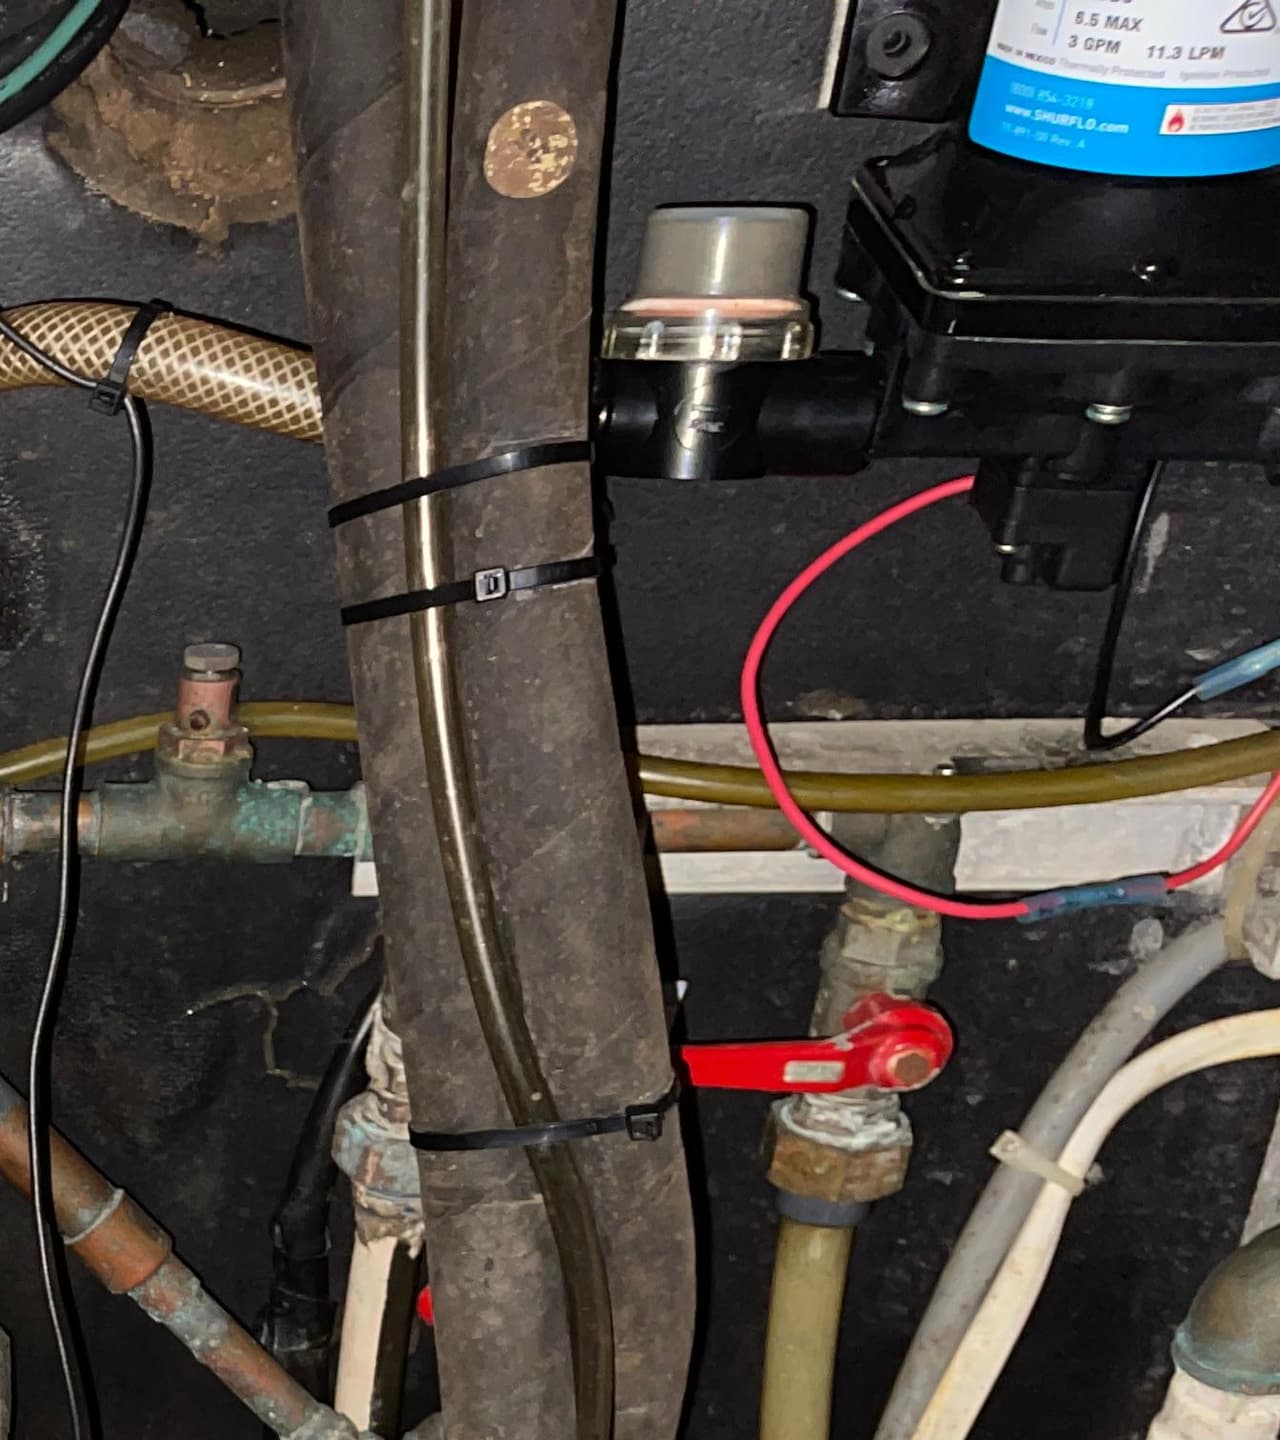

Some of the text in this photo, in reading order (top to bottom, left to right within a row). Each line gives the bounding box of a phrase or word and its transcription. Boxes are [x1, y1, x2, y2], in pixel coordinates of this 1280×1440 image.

[1104, 15, 1144, 33] MAX
[1068, 34, 1226, 60] 3 GPM 11.3 LPM
